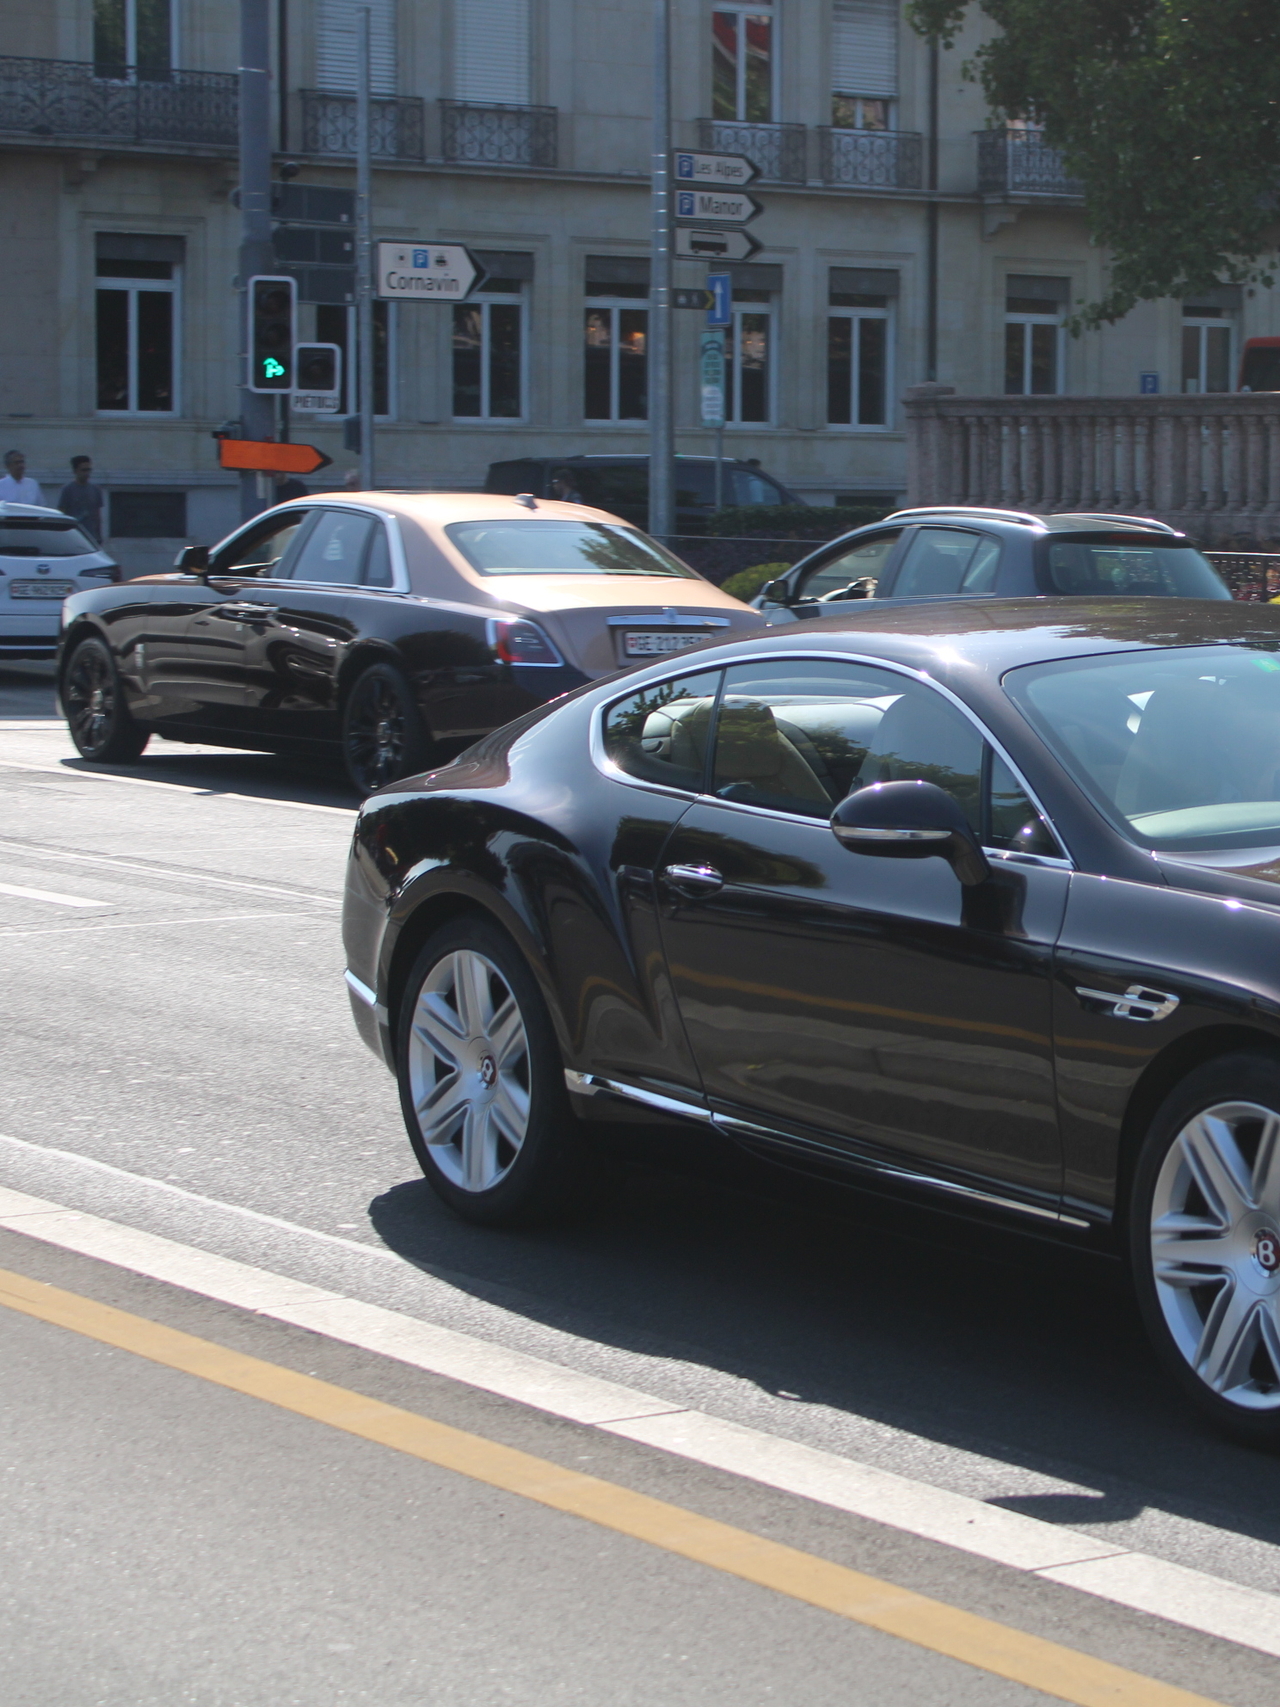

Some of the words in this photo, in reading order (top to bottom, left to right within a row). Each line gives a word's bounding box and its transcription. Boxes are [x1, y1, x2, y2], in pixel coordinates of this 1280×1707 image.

[695, 161, 712, 175] Les
[714, 161, 744, 178] Alpes
[699, 196, 744, 216] Manor
[385, 271, 460, 292] Cornavin
